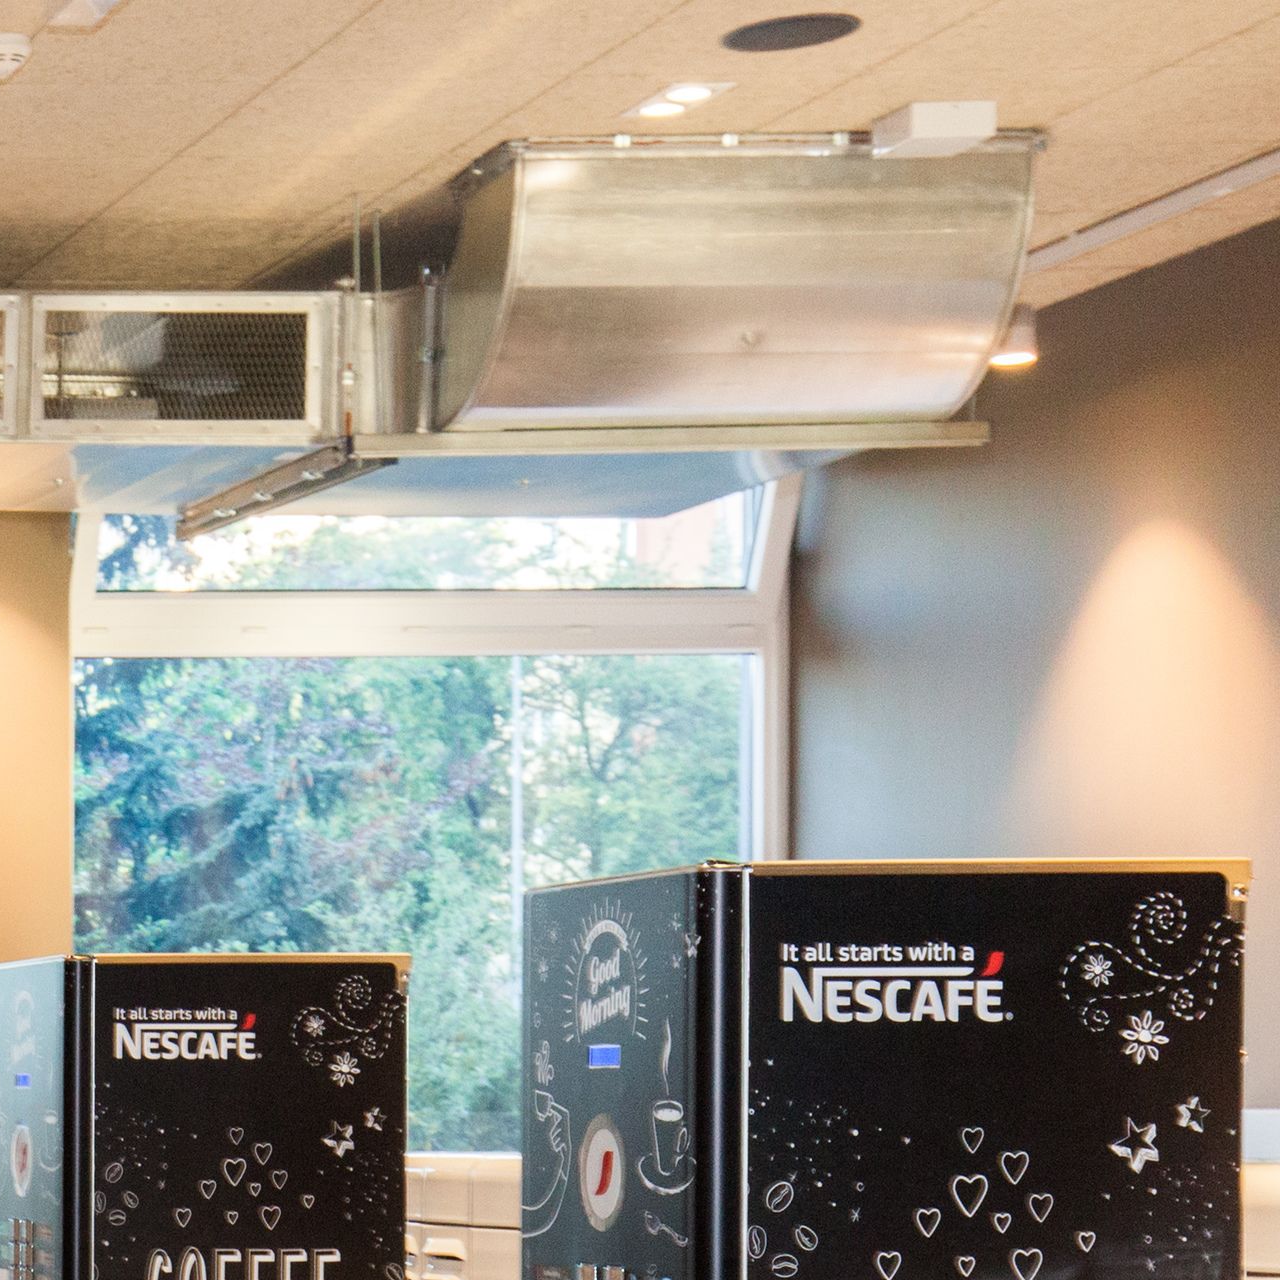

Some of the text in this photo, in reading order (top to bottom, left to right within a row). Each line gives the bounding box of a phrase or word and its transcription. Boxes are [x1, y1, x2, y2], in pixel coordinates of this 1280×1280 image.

[782, 942, 975, 962] It all starts with a
[590, 949, 621, 996] Good
[114, 1006, 238, 1020] It all starts with a
